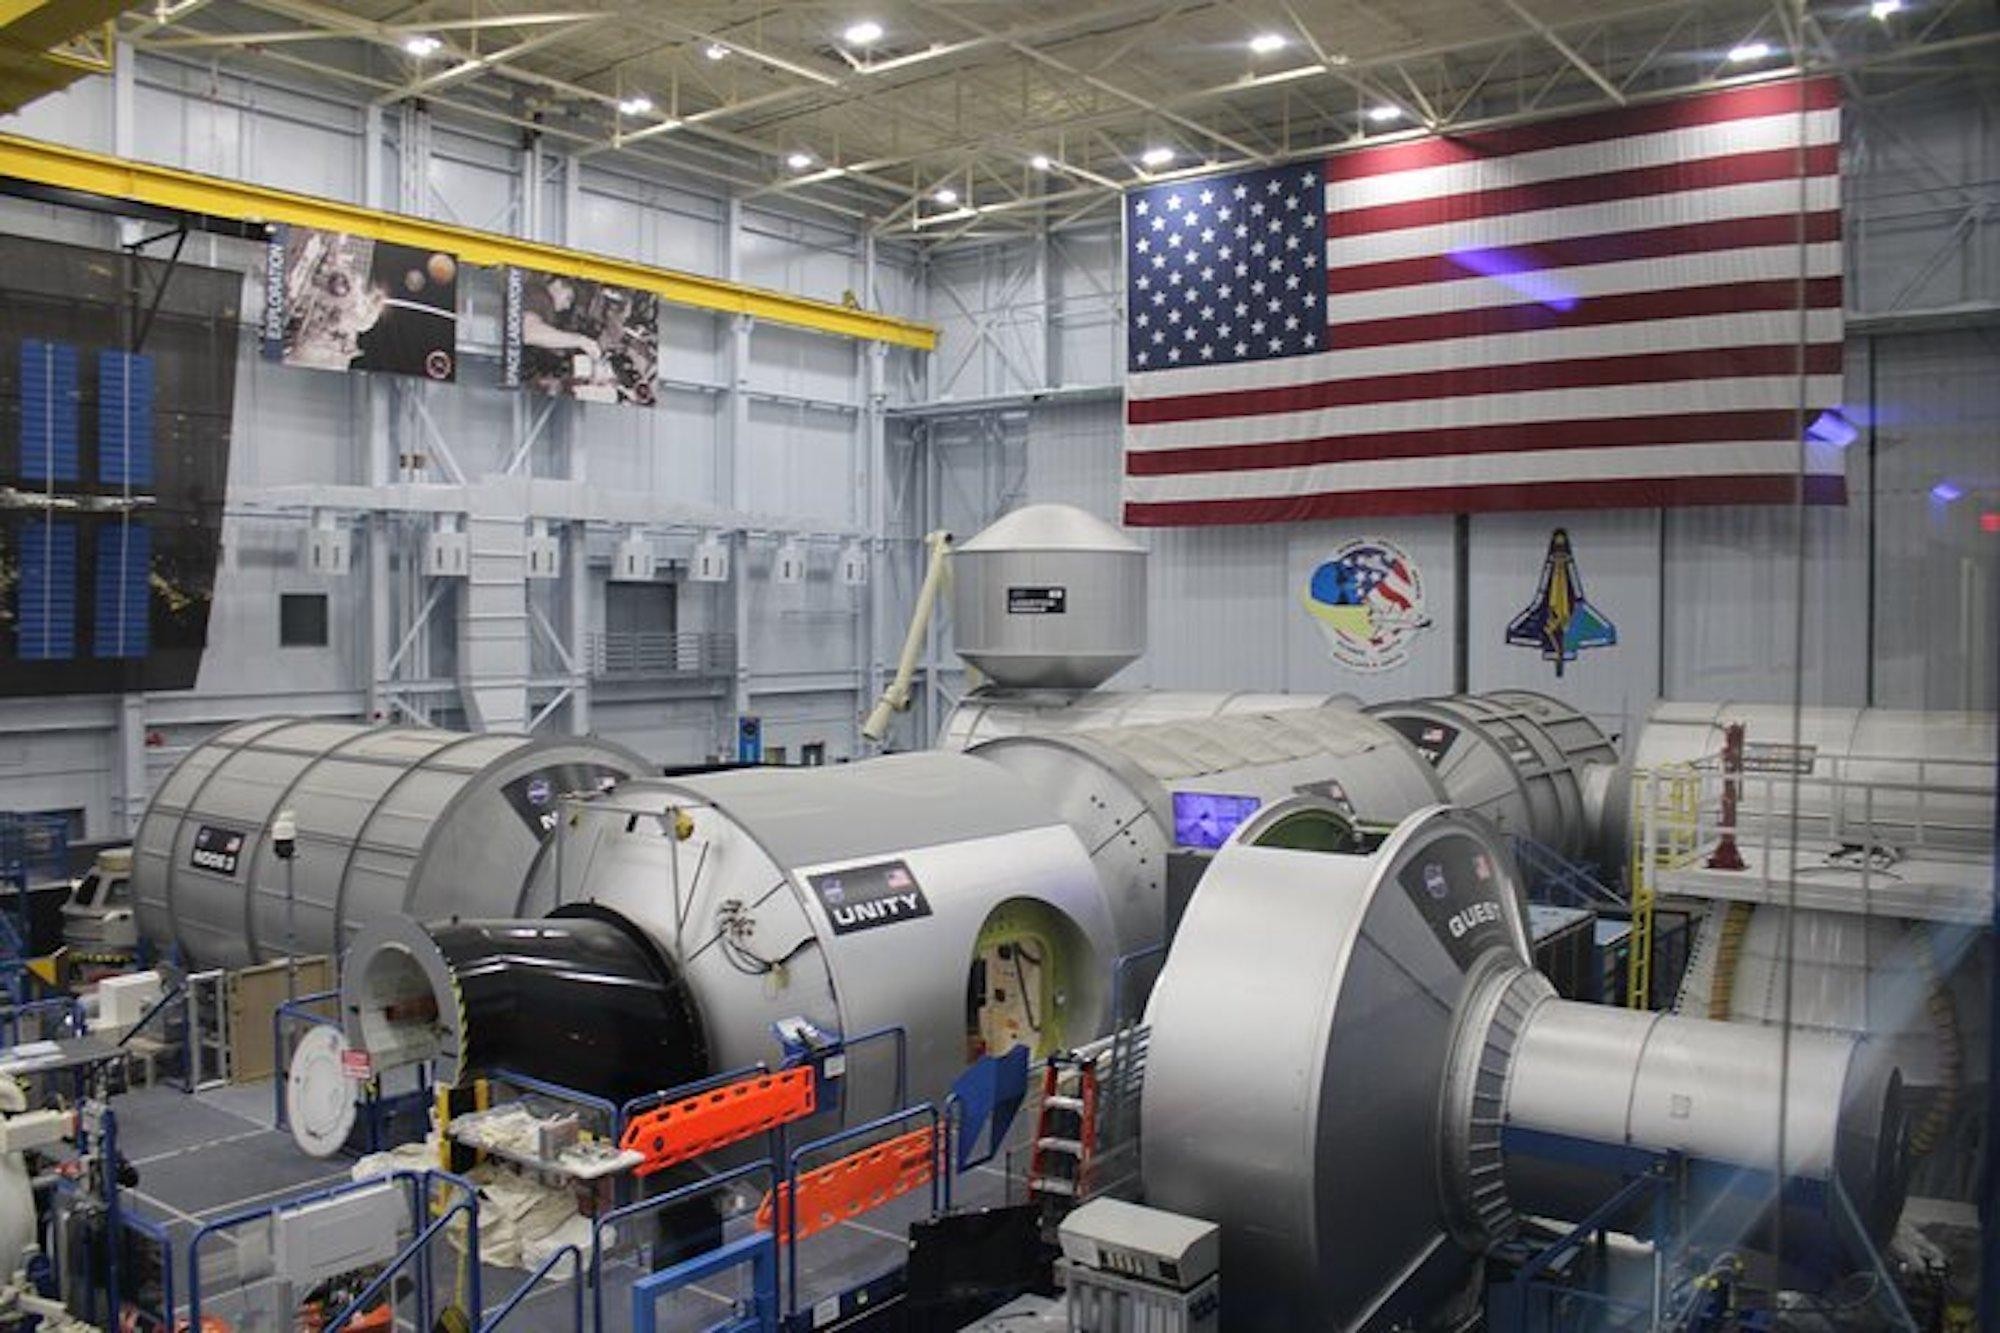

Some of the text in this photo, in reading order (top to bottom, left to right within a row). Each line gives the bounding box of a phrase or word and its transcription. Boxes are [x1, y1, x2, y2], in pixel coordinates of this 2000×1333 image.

[267, 243, 283, 340] EXPLORATION
[833, 893, 918, 926] UNITY
[1448, 901, 1500, 938] QUEST
